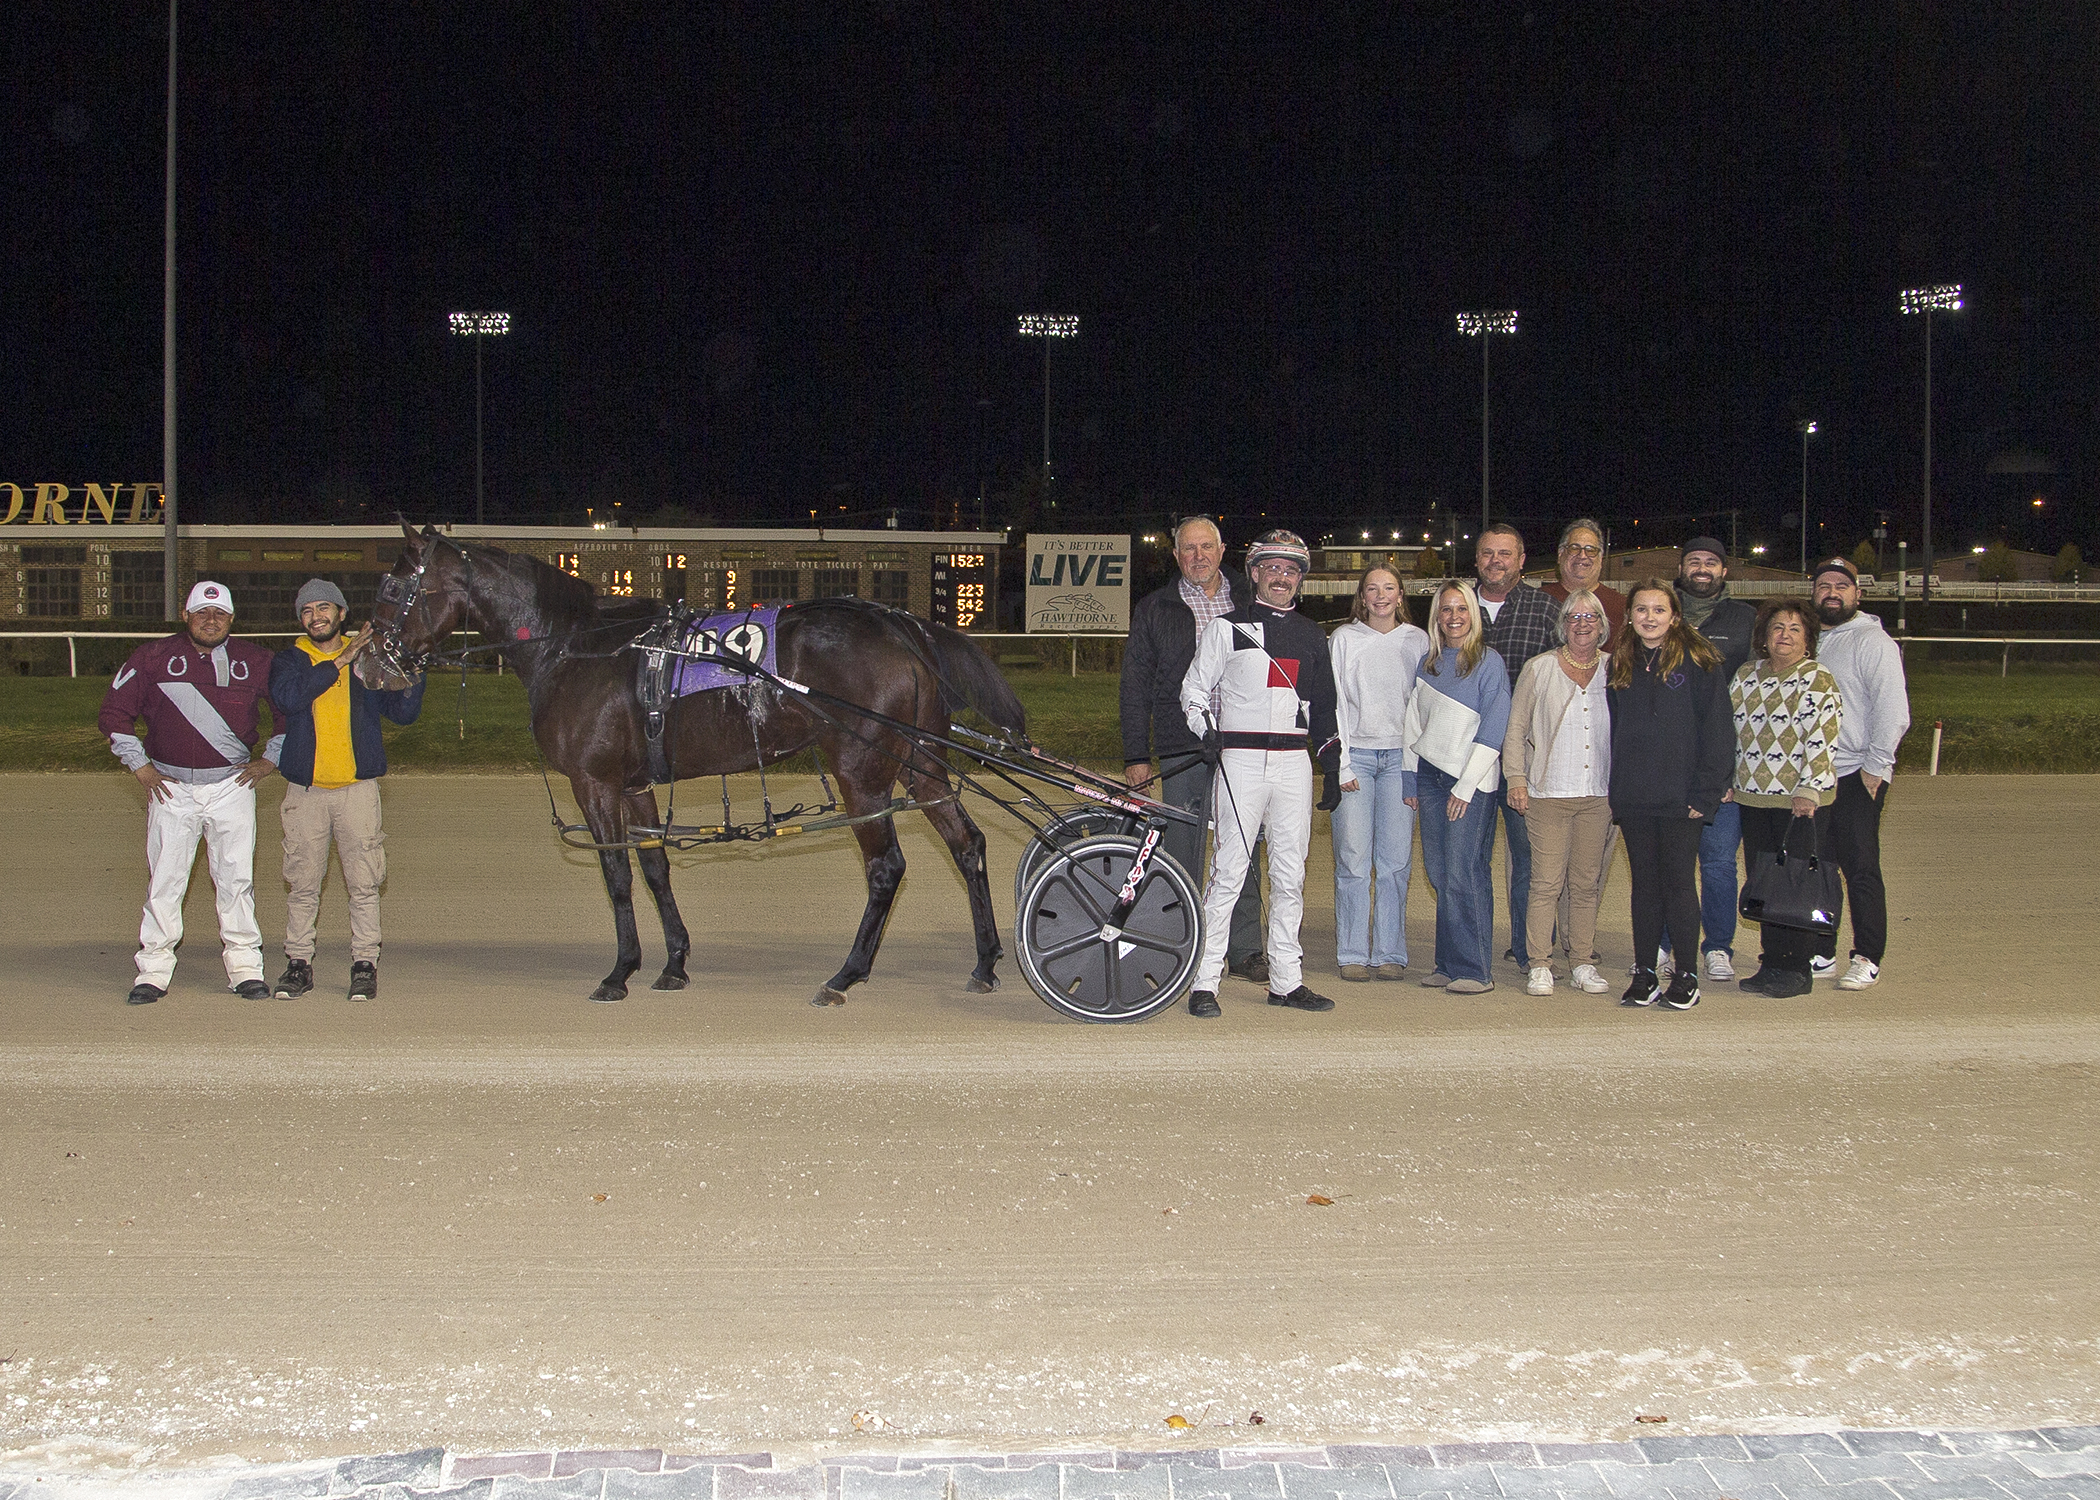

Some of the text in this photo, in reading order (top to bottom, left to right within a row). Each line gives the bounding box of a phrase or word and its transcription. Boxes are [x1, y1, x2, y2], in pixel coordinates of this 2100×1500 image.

[648, 543, 671, 552] ODDS
[1044, 539, 1114, 551] IT'S BETTER
[96, 554, 110, 566] 10
[650, 556, 661, 567] 10
[666, 554, 688, 569] 12
[703, 561, 740, 569] RESULT
[795, 561, 818, 569] TOTE
[827, 561, 863, 569] TICKETS
[935, 555, 948, 564] FIN
[16, 570, 23, 582] 6
[1029, 554, 1128, 587] LIVE
[96, 572, 107, 582] 11
[601, 572, 607, 583] 6
[614, 570, 633, 584] 14
[651, 572, 661, 583] 11
[726, 570, 737, 584] 9
[17, 587, 24, 598] 7
[96, 587, 108, 598] 12
[651, 588, 662, 599] 12
[935, 587, 947, 597] 3/4
[957, 584, 984, 598] 223
[16, 603, 23, 615] 8
[96, 604, 108, 615] 13
[936, 604, 947, 613] 1/2
[957, 598, 984, 612] 542
[957, 613, 974, 627] 27
[1040, 613, 1118, 623] HAWTHORNE
[725, 624, 764, 672] 9
